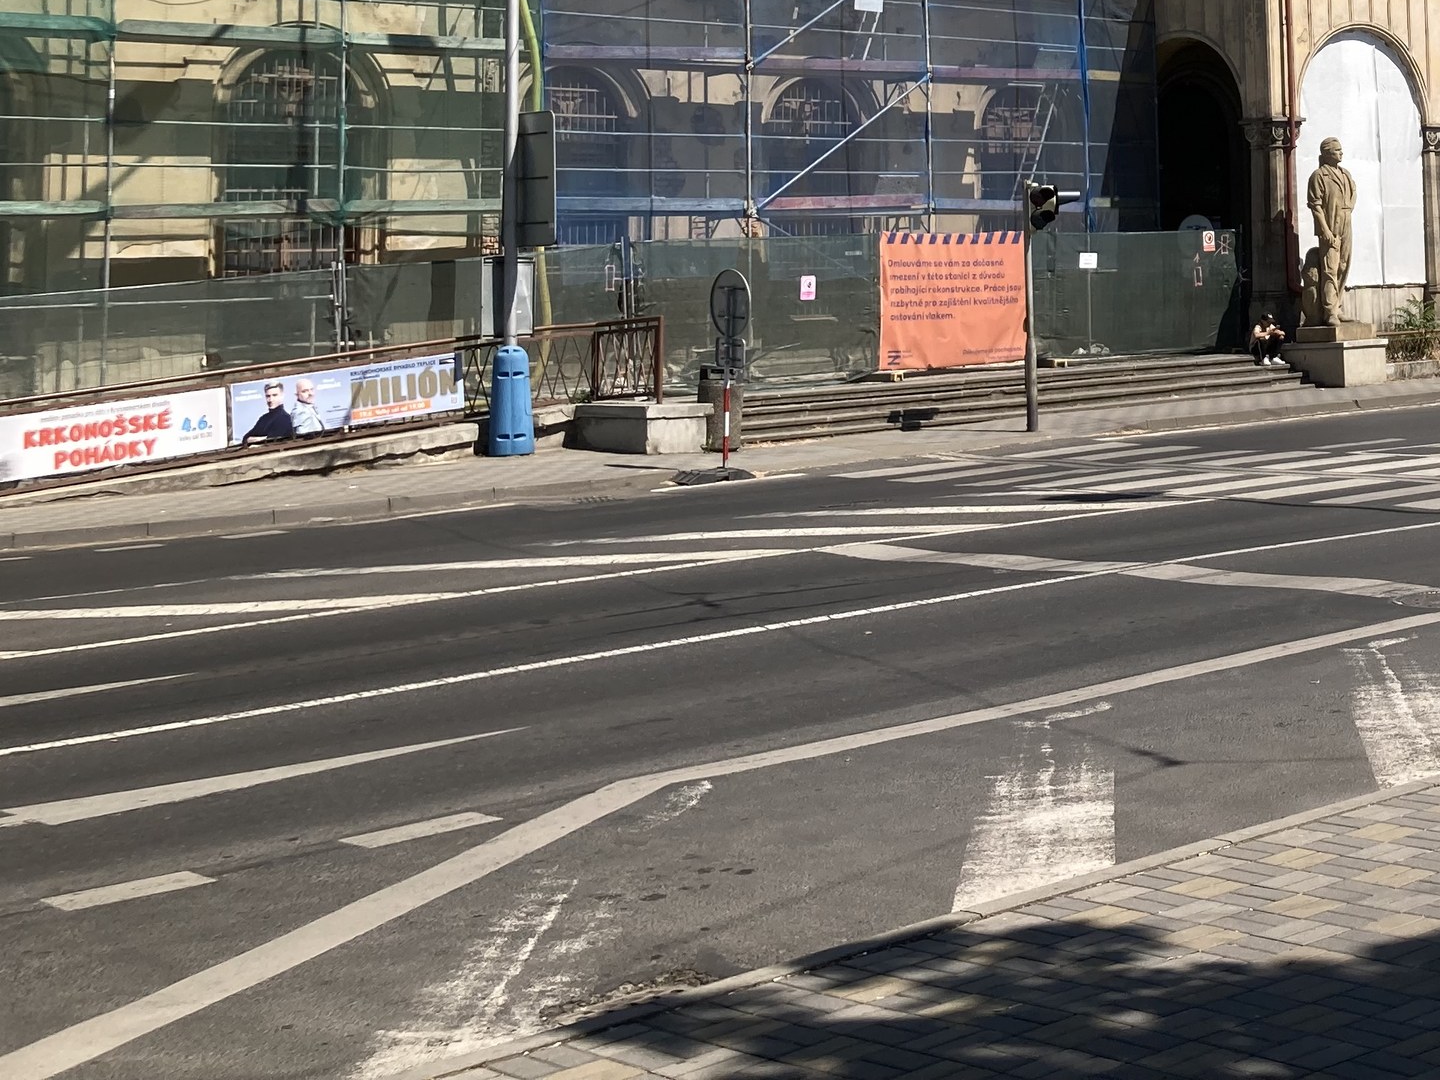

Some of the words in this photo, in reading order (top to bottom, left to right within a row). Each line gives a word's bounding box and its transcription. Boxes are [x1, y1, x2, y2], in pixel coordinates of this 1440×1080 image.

[888, 259, 933, 268] Omlouváme
[933, 260, 943, 268] se
[944, 259, 960, 267] vám
[926, 272, 943, 280] této
[928, 284, 982, 294] rekonstrukce.
[983, 283, 1006, 292] Práce
[1006, 283, 1022, 293] jsou
[890, 299, 923, 309] nzbytné
[924, 300, 937, 308] pro
[938, 298, 972, 308] zajištění
[890, 313, 925, 321] cstování
[350, 365, 393, 377] KRUŠNOHORSKÉ
[350, 365, 458, 409] MILIÓN
[23, 407, 173, 450] KRKONOŠSKÉ
[181, 414, 213, 433] 4.6.
[53, 437, 159, 470] POHÁDKY
